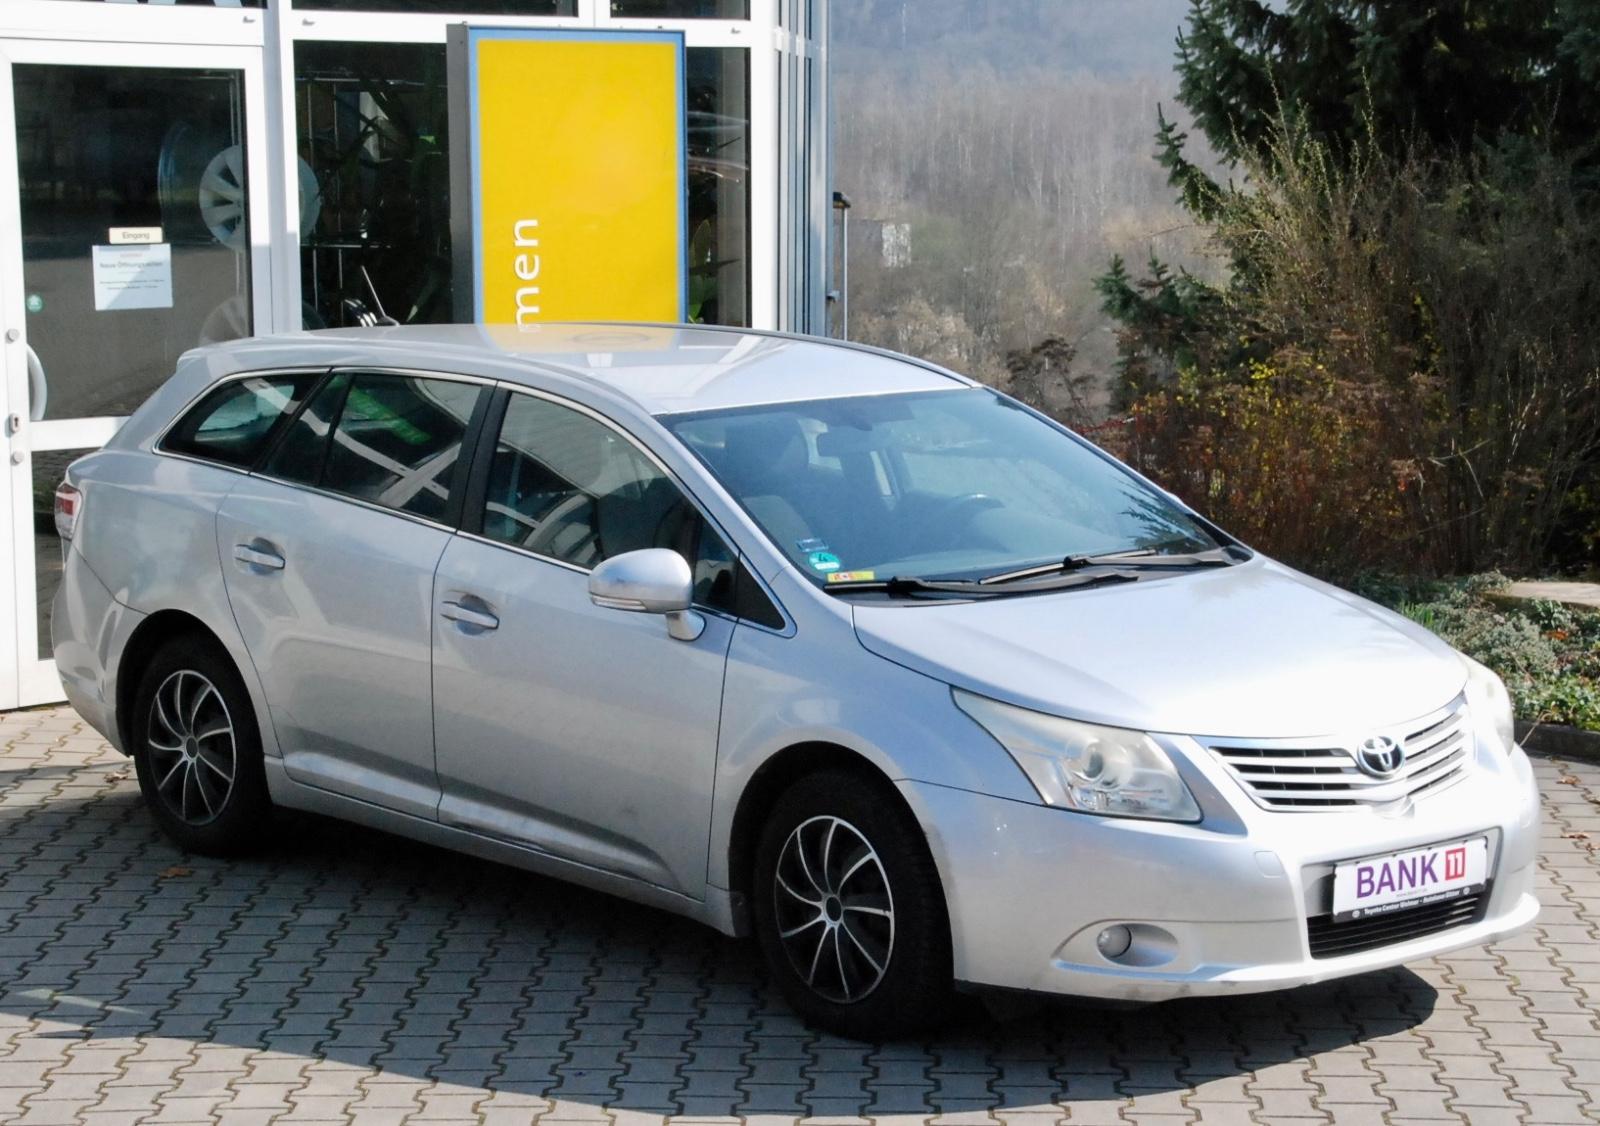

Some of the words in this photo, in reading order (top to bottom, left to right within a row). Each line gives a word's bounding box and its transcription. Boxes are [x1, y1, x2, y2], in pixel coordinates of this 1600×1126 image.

[122, 232, 150, 240] Eingang
[1356, 853, 1438, 898] BANK
[1446, 849, 1465, 880] 11
